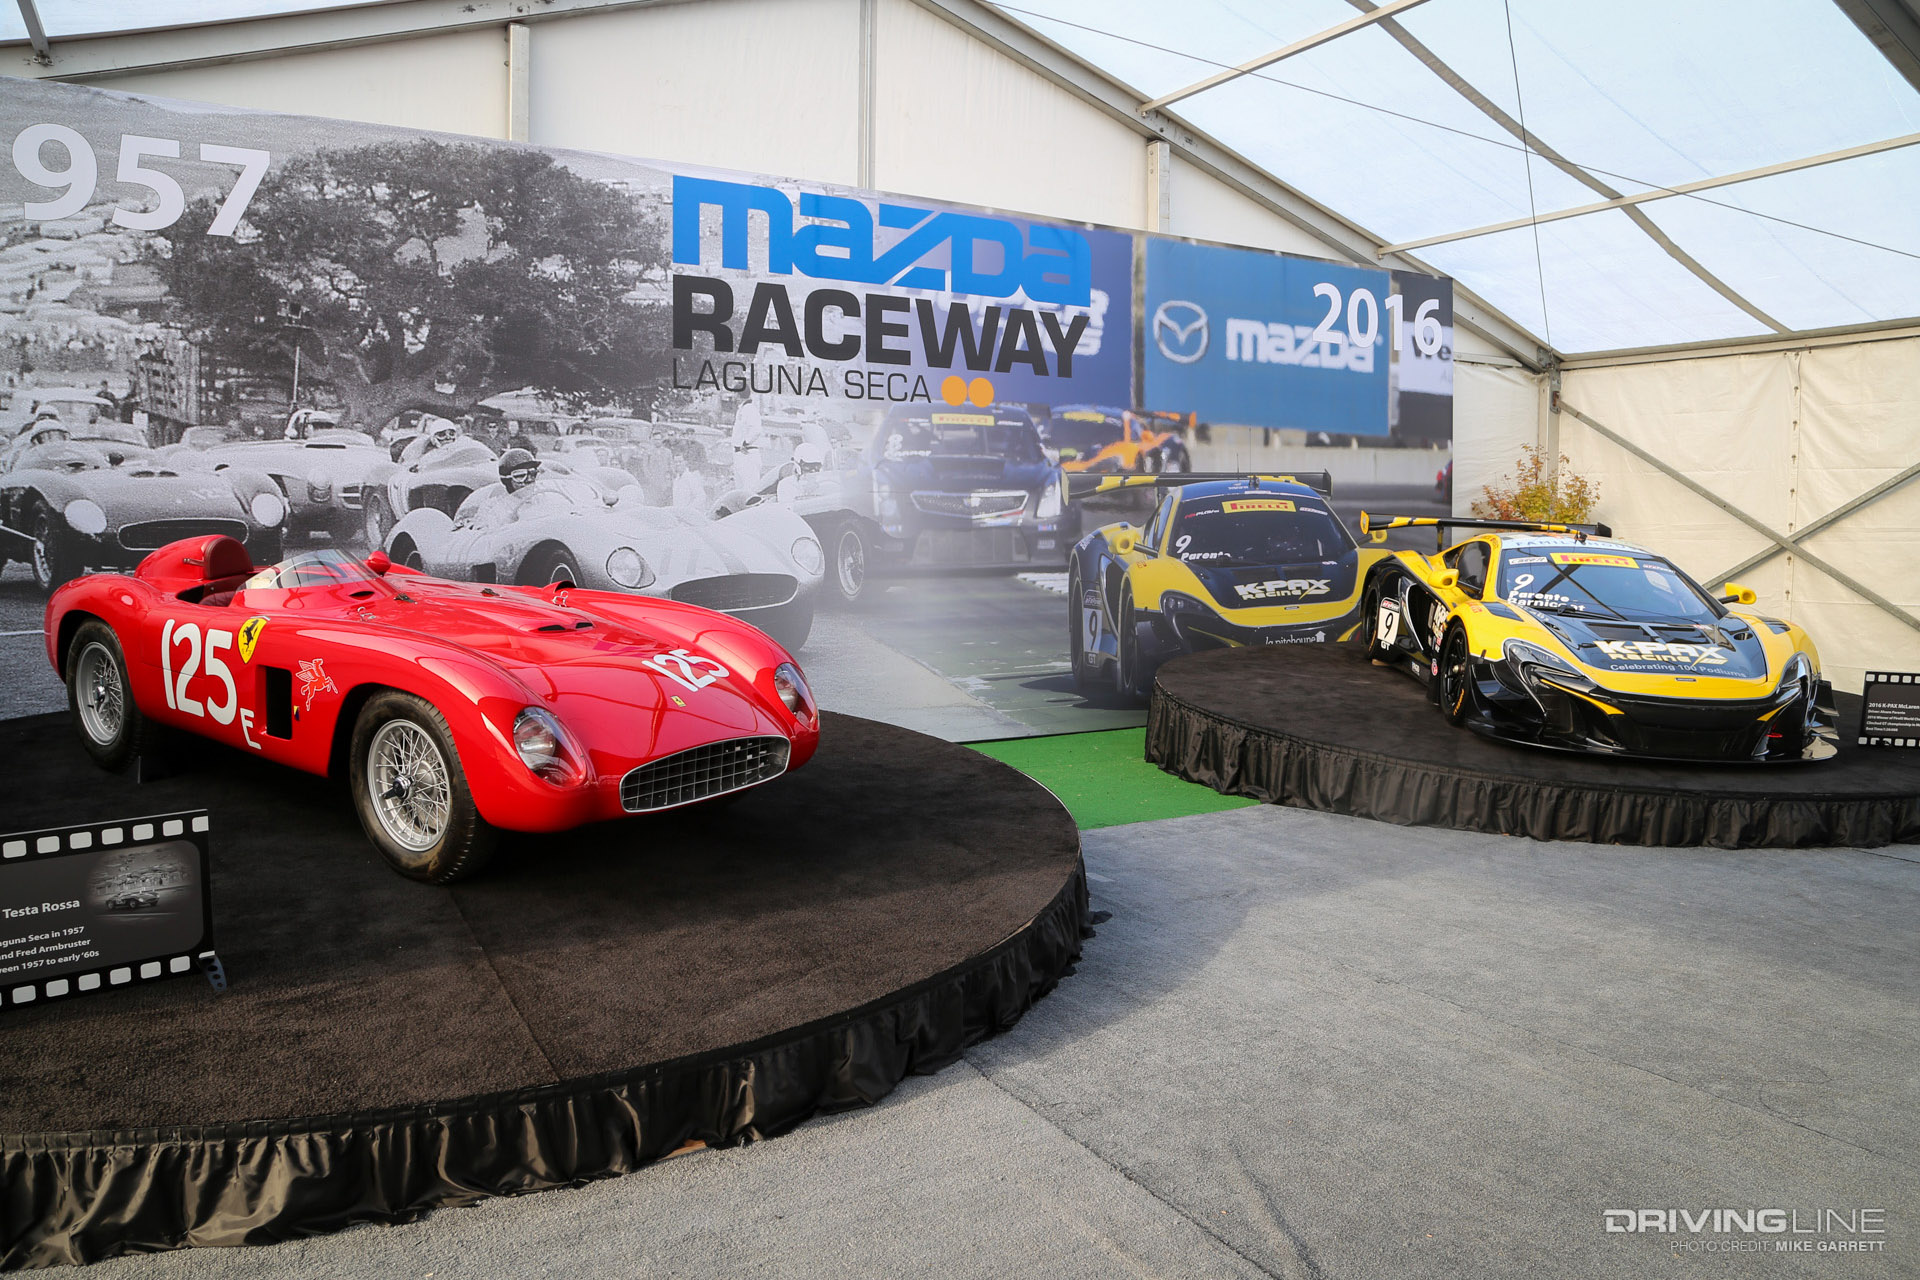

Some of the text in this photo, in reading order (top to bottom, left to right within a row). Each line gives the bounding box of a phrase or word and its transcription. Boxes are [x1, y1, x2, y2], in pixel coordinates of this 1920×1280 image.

[672, 174, 1091, 308] mazda
[672, 273, 1090, 379] RACEWAY
[1312, 282, 1444, 356] 2016
[673, 357, 932, 404] LAGUNA SECA
[1230, 502, 1289, 510] PIRELLI
[1175, 535, 1192, 553] 9
[1559, 554, 1630, 566] PIRELLI
[1233, 579, 1332, 600] K-PAX
[1514, 573, 1536, 592] 9
[1509, 590, 1571, 603] Parente
[1089, 610, 1098, 652] 9
[1384, 612, 1394, 639] 9
[1380, 640, 1392, 651] GT
[1593, 640, 1728, 667] K-PAX
[641, 648, 730, 692] 125
[1610, 663, 1748, 678] Celebrating 100 Podiums
[161, 618, 262, 750] 125 E
[2, 900, 80, 919] Testa Rossa
[28, 932, 50, 942] Seca
[62, 926, 85, 936] 1957
[0, 939, 91, 960] nd Fred Armbruster
[21, 959, 44, 970] 1957
[46, 958, 56, 966] to
[57, 953, 80, 962] early
